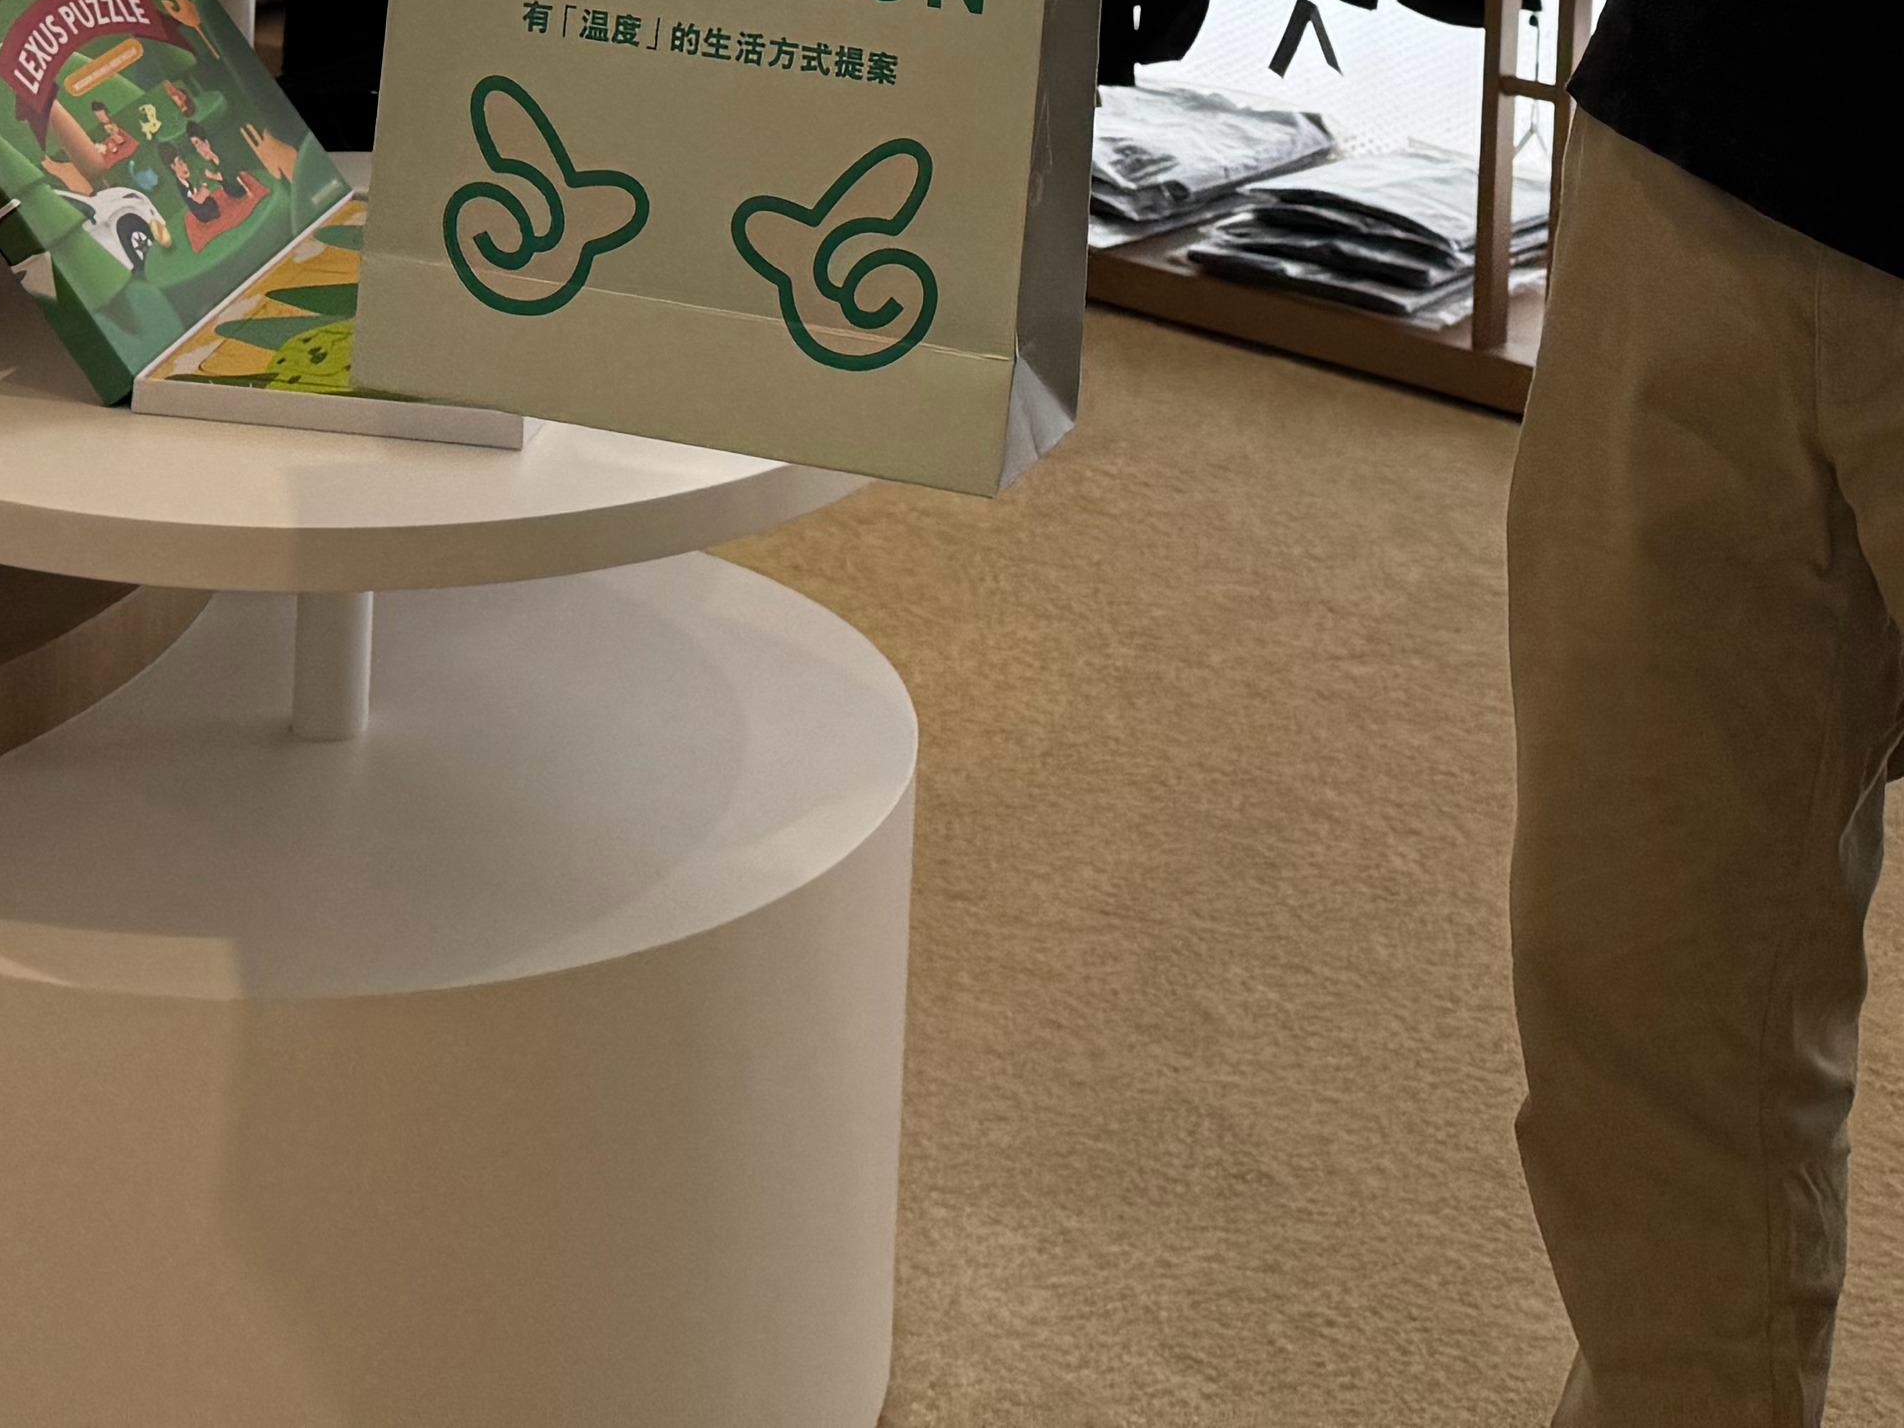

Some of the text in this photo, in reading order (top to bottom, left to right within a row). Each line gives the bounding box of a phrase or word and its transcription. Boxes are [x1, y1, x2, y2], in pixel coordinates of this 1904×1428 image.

[13, 14, 69, 95] LEXUS
[521, 0, 899, 86] 有「温度」的生活方式提案
